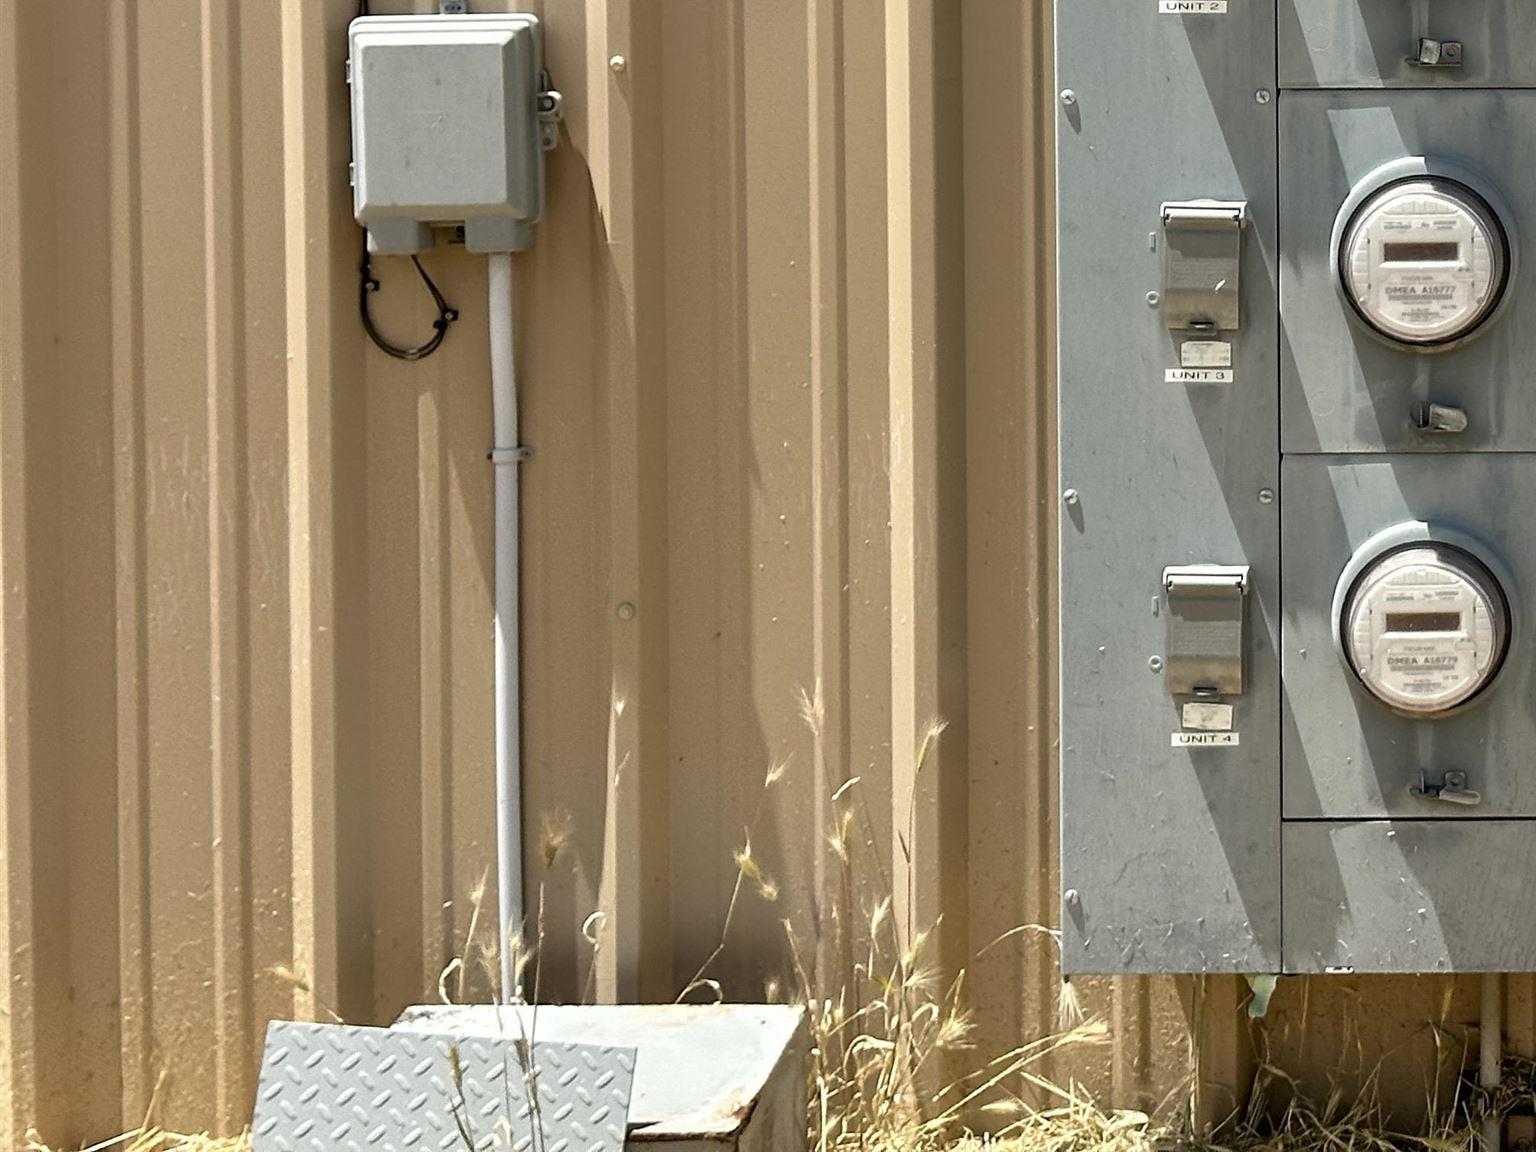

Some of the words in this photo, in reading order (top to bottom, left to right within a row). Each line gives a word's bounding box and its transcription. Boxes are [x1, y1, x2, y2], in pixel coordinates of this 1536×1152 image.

[1166, 2, 1204, 11] UNIT
[1209, 2, 1219, 11] 2
[1172, 371, 1211, 380] UNIT
[1216, 371, 1225, 380] 3
[1179, 735, 1217, 743] UNIT
[1223, 735, 1231, 743] 4
